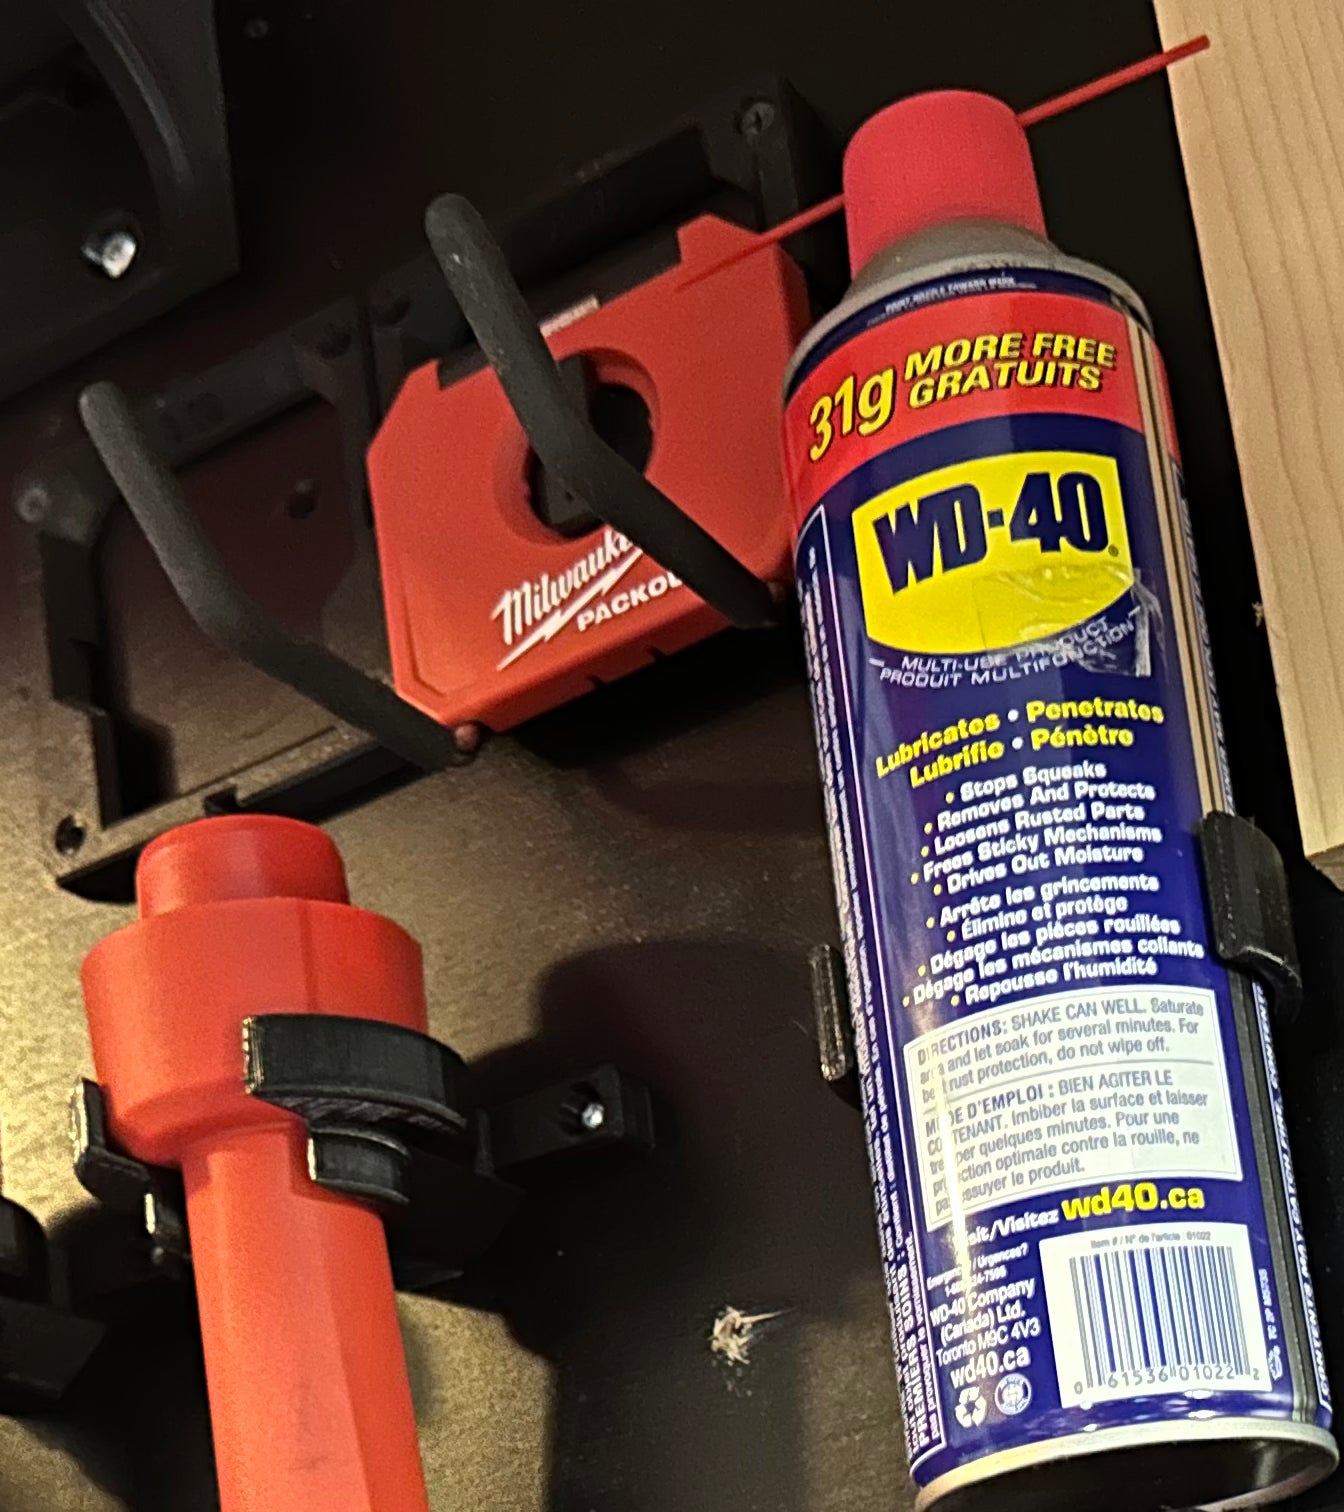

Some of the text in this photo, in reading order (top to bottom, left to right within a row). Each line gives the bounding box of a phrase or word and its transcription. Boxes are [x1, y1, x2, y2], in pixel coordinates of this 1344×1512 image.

[809, 332, 1117, 462] 31g MORE FREE
[908, 360, 1104, 410] GRATUITS
[880, 619, 1135, 689] PRODUIT MULTIFONCTION
[875, 697, 1165, 778] Lubricates Penetrates
[909, 725, 1134, 788] Lubrifie Pénètre
[937, 781, 1156, 832] Removes And Protects
[960, 760, 1107, 803] Stops Squeaks
[923, 821, 1162, 882] Frees Sticky Mechanisms
[934, 799, 1145, 856] Loosens Rusted Parts
[947, 845, 1144, 895] Drives Out Moisture
[940, 874, 1160, 926] Arrête les grincements
[962, 897, 1128, 941] Élimine et protège
[930, 916, 1181, 975] Dégage les pièces rouillées
[913, 939, 1205, 1006] Dégage les mécanismes collants
[965, 956, 1158, 1005] Repousse l'humidité
[918, 997, 1204, 1066] DIRECTIONS: SHAKE CAN WELL. Saturate
[947, 1049, 971, 1073] and
[974, 1044, 993, 1062] let
[995, 1034, 1030, 1056] soak
[1033, 1029, 1053, 1046] for
[1057, 1019, 1112, 1041] several
[1115, 1017, 1176, 1034] minutes.
[1178, 1017, 1199, 1034] For
[949, 1069, 974, 1091] rust
[977, 1050, 1054, 1084] protection,
[1057, 1044, 1076, 1061] do
[1079, 1039, 1104, 1057] not
[1108, 1037, 1143, 1056] wipe
[1146, 1036, 1171, 1052] off.
[967, 1083, 1043, 1119] D'EMPLOI
[1058, 1075, 1094, 1096] BIEN
[1098, 1070, 1152, 1090] AGITER
[1154, 1070, 1174, 1086] LE
[1011, 1101, 1068, 1127] Imbiber
[1071, 1098, 1086, 1114] la
[1089, 1092, 1145, 1111] surface
[1148, 1090, 1164, 1106] et
[1165, 1089, 1209, 1107] laisser
[979, 1127, 1043, 1158] quelques
[1046, 1116, 1112, 1138] minutes.
[1115, 1111, 1150, 1127] Pour
[1153, 1111, 1180, 1125] une
[995, 1143, 1058, 1172] optimale
[1061, 1134, 1109, 1155] contre
[1112, 1131, 1127, 1147] la
[1130, 1128, 1180, 1147] rouille,
[1182, 1131, 1200, 1145] ne
[1011, 1171, 1024, 1187] le
[1028, 1157, 1086, 1186] produit.
[1061, 1182, 1205, 1222] wd40.ca
[894, 1263, 916, 1332] SOINS
[929, 1296, 966, 1327] WD-40
[967, 1278, 1035, 1309] Company
[936, 1317, 1042, 1367] Toronto M9C 4V3
[940, 1300, 1027, 1348] (Canada) Ltd.
[903, 1333, 932, 1447] PREMIERS
[950, 1346, 1032, 1389] wd40.ca
[1107, 1367, 1170, 1389] 61536
[1178, 1365, 1235, 1382] 01022
